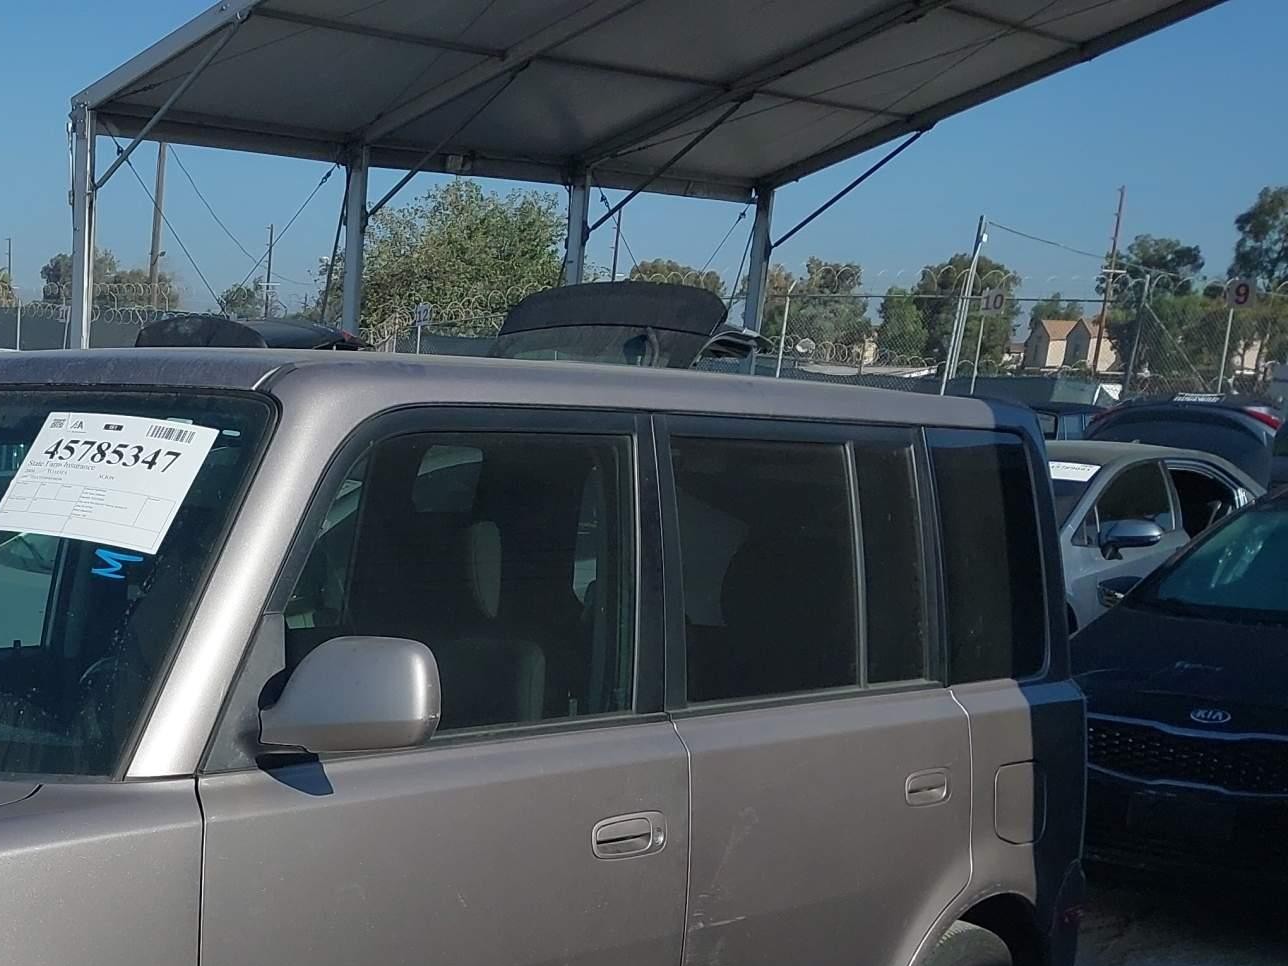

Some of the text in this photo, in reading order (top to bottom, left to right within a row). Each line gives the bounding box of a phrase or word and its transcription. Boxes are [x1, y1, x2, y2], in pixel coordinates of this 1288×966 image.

[982, 293, 1004, 311] 10
[1234, 282, 1250, 305] 9
[44, 438, 182, 472] 45785347
[1194, 709, 1224, 721] KIA
